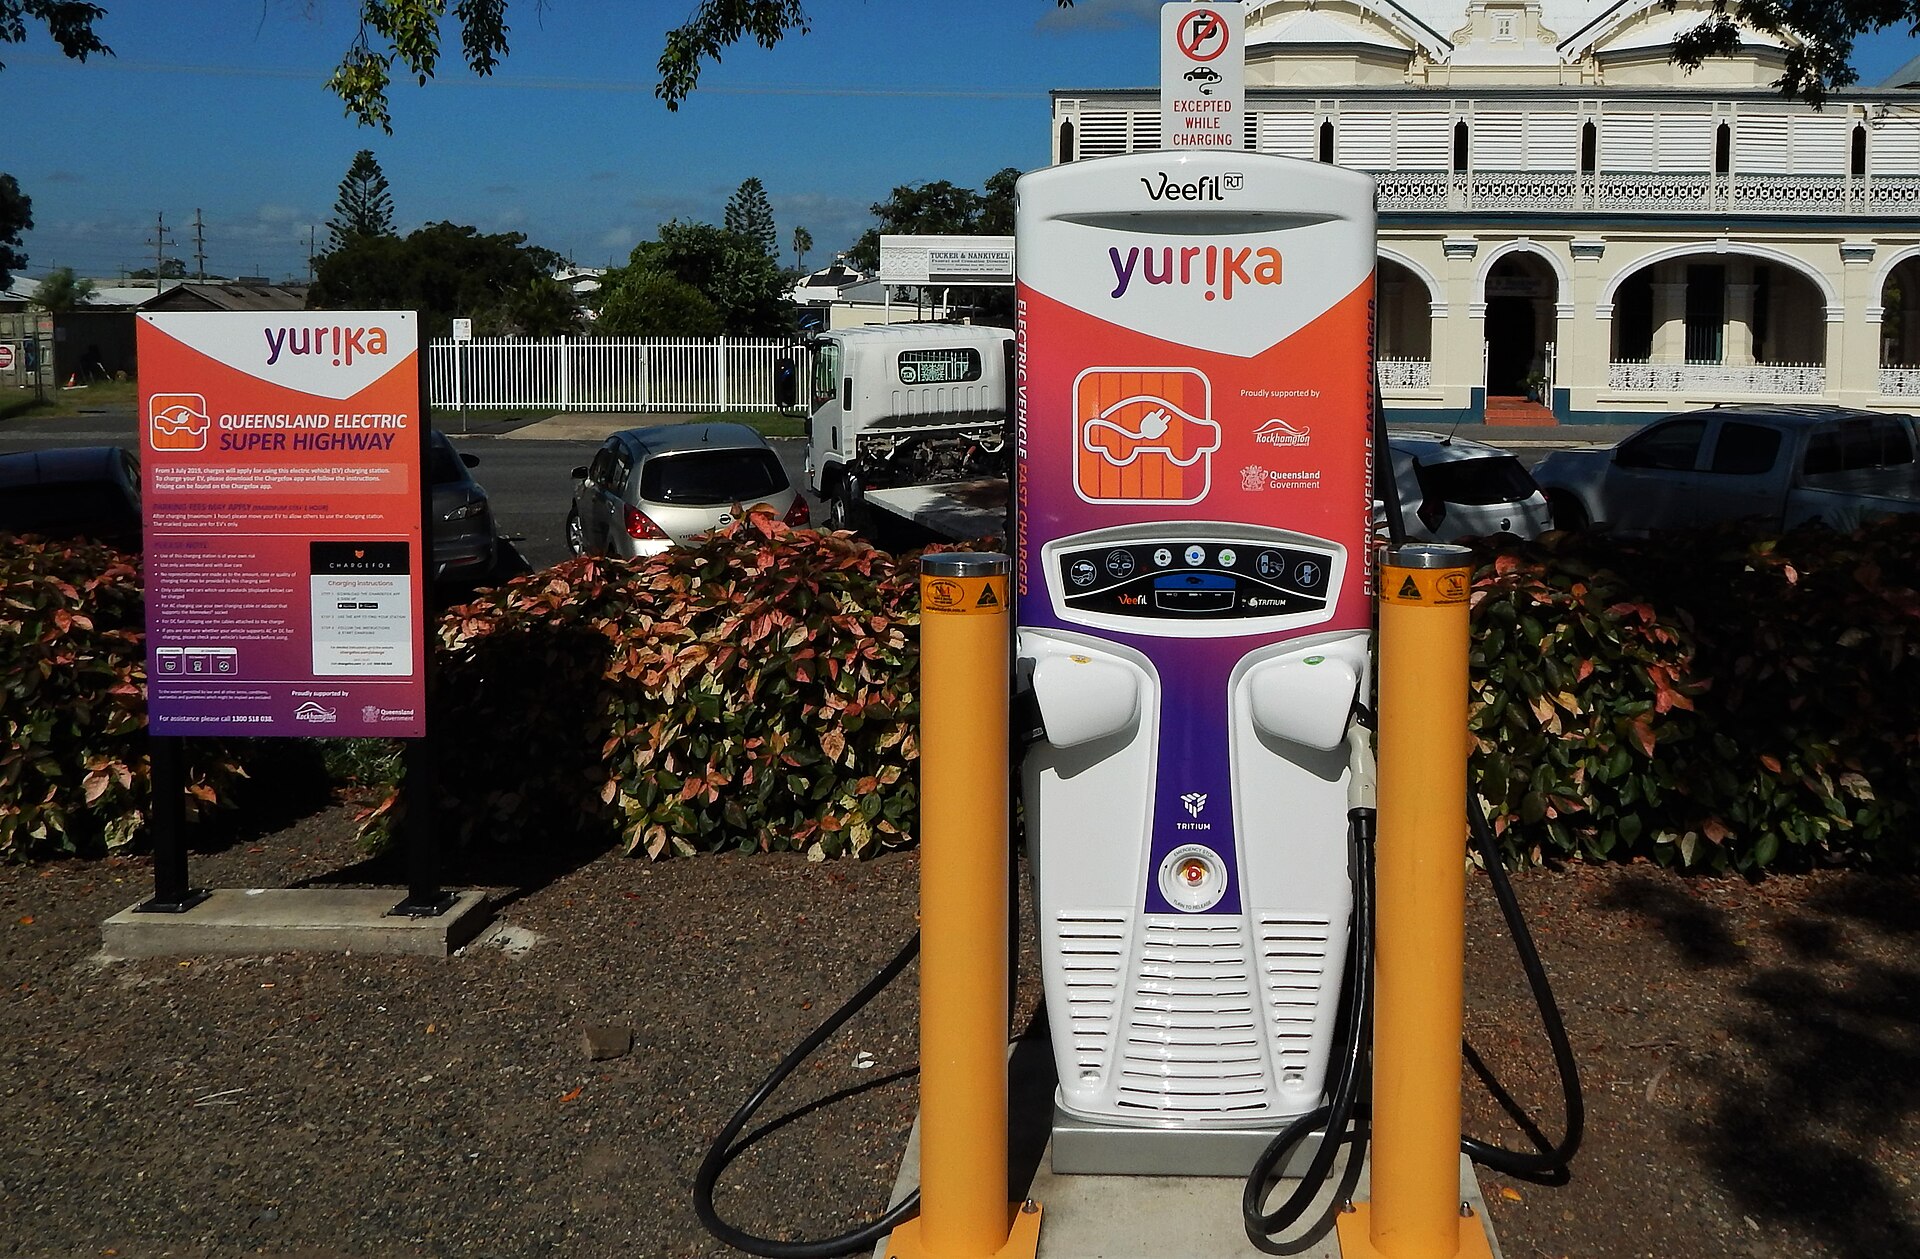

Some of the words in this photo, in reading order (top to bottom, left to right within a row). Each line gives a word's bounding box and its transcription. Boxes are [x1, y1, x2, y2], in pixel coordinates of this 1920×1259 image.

[1174, 100, 1232, 112] EXCEPTED
[1185, 117, 1220, 128] WHILE
[1173, 134, 1232, 146] CHARGING
[1140, 172, 1224, 200] Veefil
[1224, 174, 1243, 188] RT
[1018, 300, 1027, 382] ELECTRIC
[1367, 299, 1375, 385] CHARGER
[1240, 389, 1269, 398] Proudly
[1271, 389, 1309, 398] supported
[1310, 389, 1320, 398] by
[218, 414, 330, 430] QUEENSLAND
[334, 414, 407, 429] ELECTRIC
[1018, 386, 1027, 460] VEHICLE
[220, 433, 286, 451] SUPER
[293, 432, 395, 451] HIGHWAY
[1256, 433, 1310, 444] Rockhampton
[1270, 471, 1320, 479] Queensland
[1018, 463, 1027, 507] FAST
[1270, 480, 1320, 489] Government
[1018, 510, 1028, 596] CHARGER
[1364, 516, 1372, 596] ELECTRIC
[1118, 594, 1148, 605] Veefil
[1174, 847, 1202, 857] EMERGENCY
[1202, 849, 1214, 858] STOP
[1173, 900, 1185, 909] TURN
[1193, 900, 1212, 910] RELEASE
